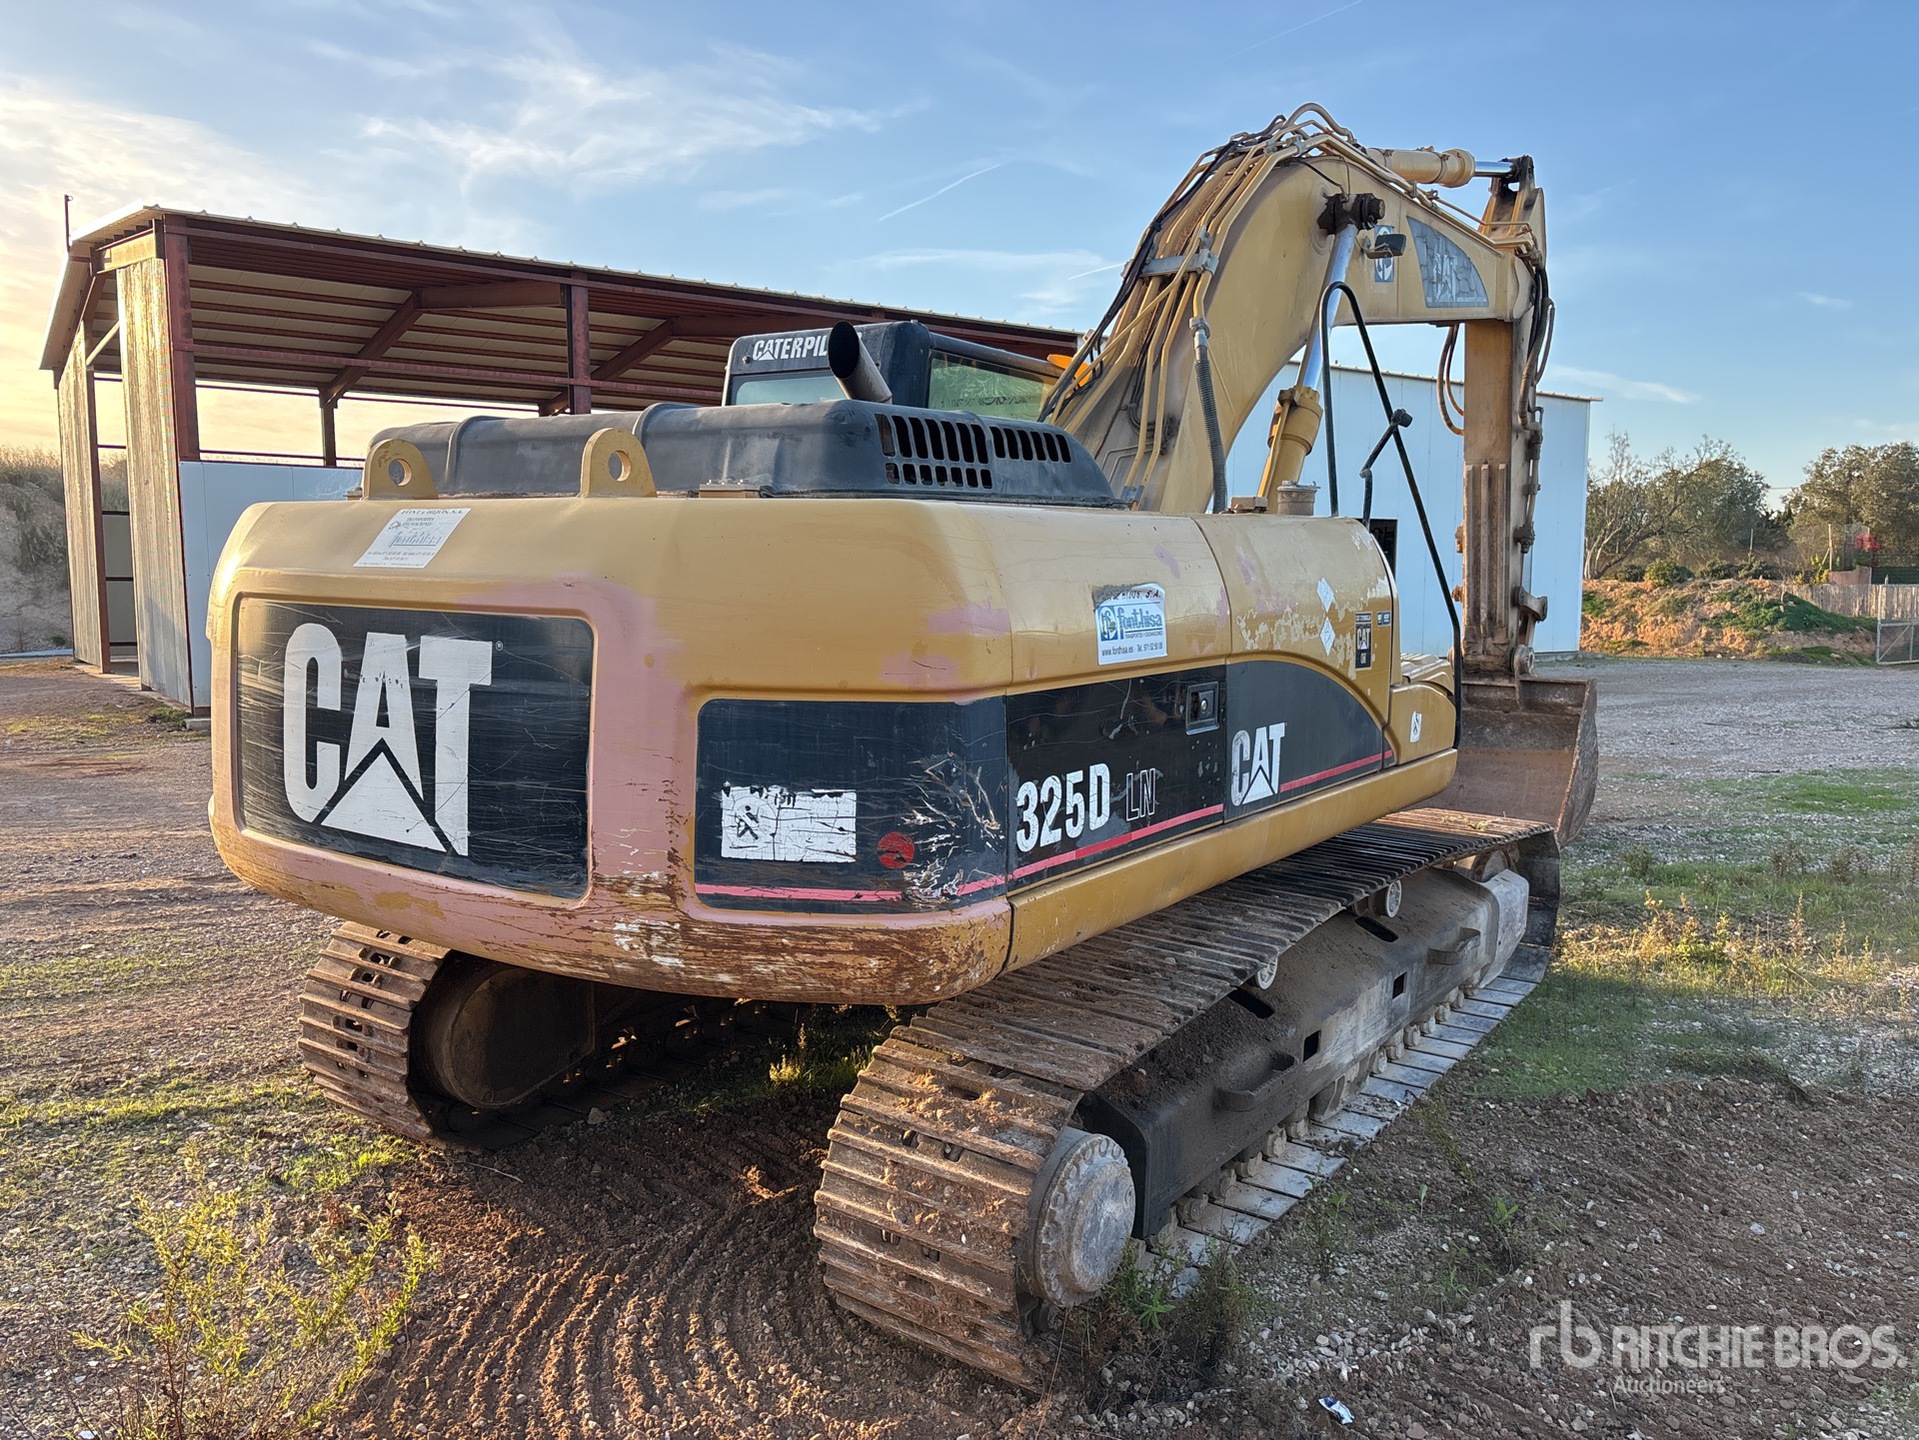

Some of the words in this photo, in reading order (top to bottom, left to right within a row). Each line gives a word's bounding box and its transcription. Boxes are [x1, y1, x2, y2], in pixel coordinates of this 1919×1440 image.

[753, 332, 862, 361] CATERPIL
[1117, 606, 1163, 639] fonthisa
[1356, 628, 1371, 651] CAT
[283, 623, 493, 857] CAT
[1231, 722, 1286, 807] CAT
[1016, 763, 1111, 853] 325D
[1126, 768, 1157, 822] LN
